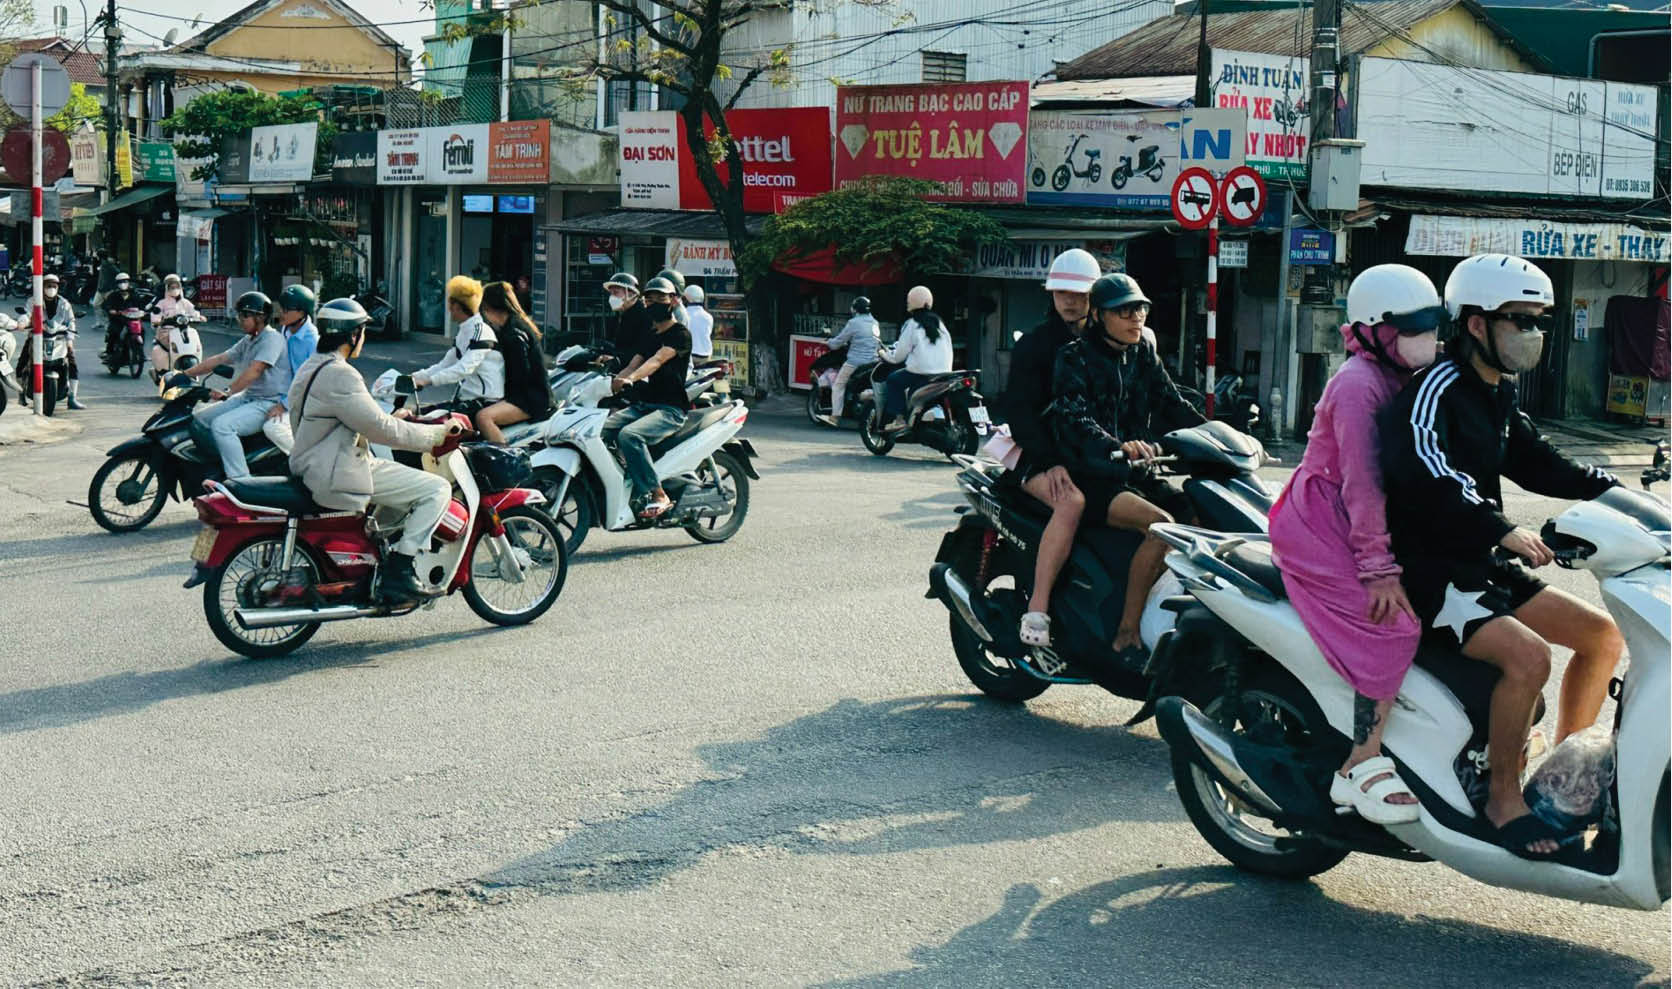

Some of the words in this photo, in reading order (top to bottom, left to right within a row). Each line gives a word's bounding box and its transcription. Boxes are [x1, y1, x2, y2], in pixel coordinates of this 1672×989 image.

[869, 94, 915, 113] TRANG
[918, 94, 950, 116] BẠC
[953, 92, 983, 112] CAO
[988, 85, 1020, 111] CẤP
[1253, 96, 1272, 120] XE
[1567, 91, 1588, 115] GAS
[623, 146, 645, 164] ĐẠI
[647, 145, 675, 161] SƠN
[873, 120, 923, 168] TUỆ
[929, 120, 985, 159] LÂM
[742, 171, 795, 187] telecom
[1521, 223, 1564, 257] RỬA
[1572, 233, 1598, 258] XE
[1618, 234, 1666, 260] THAY
